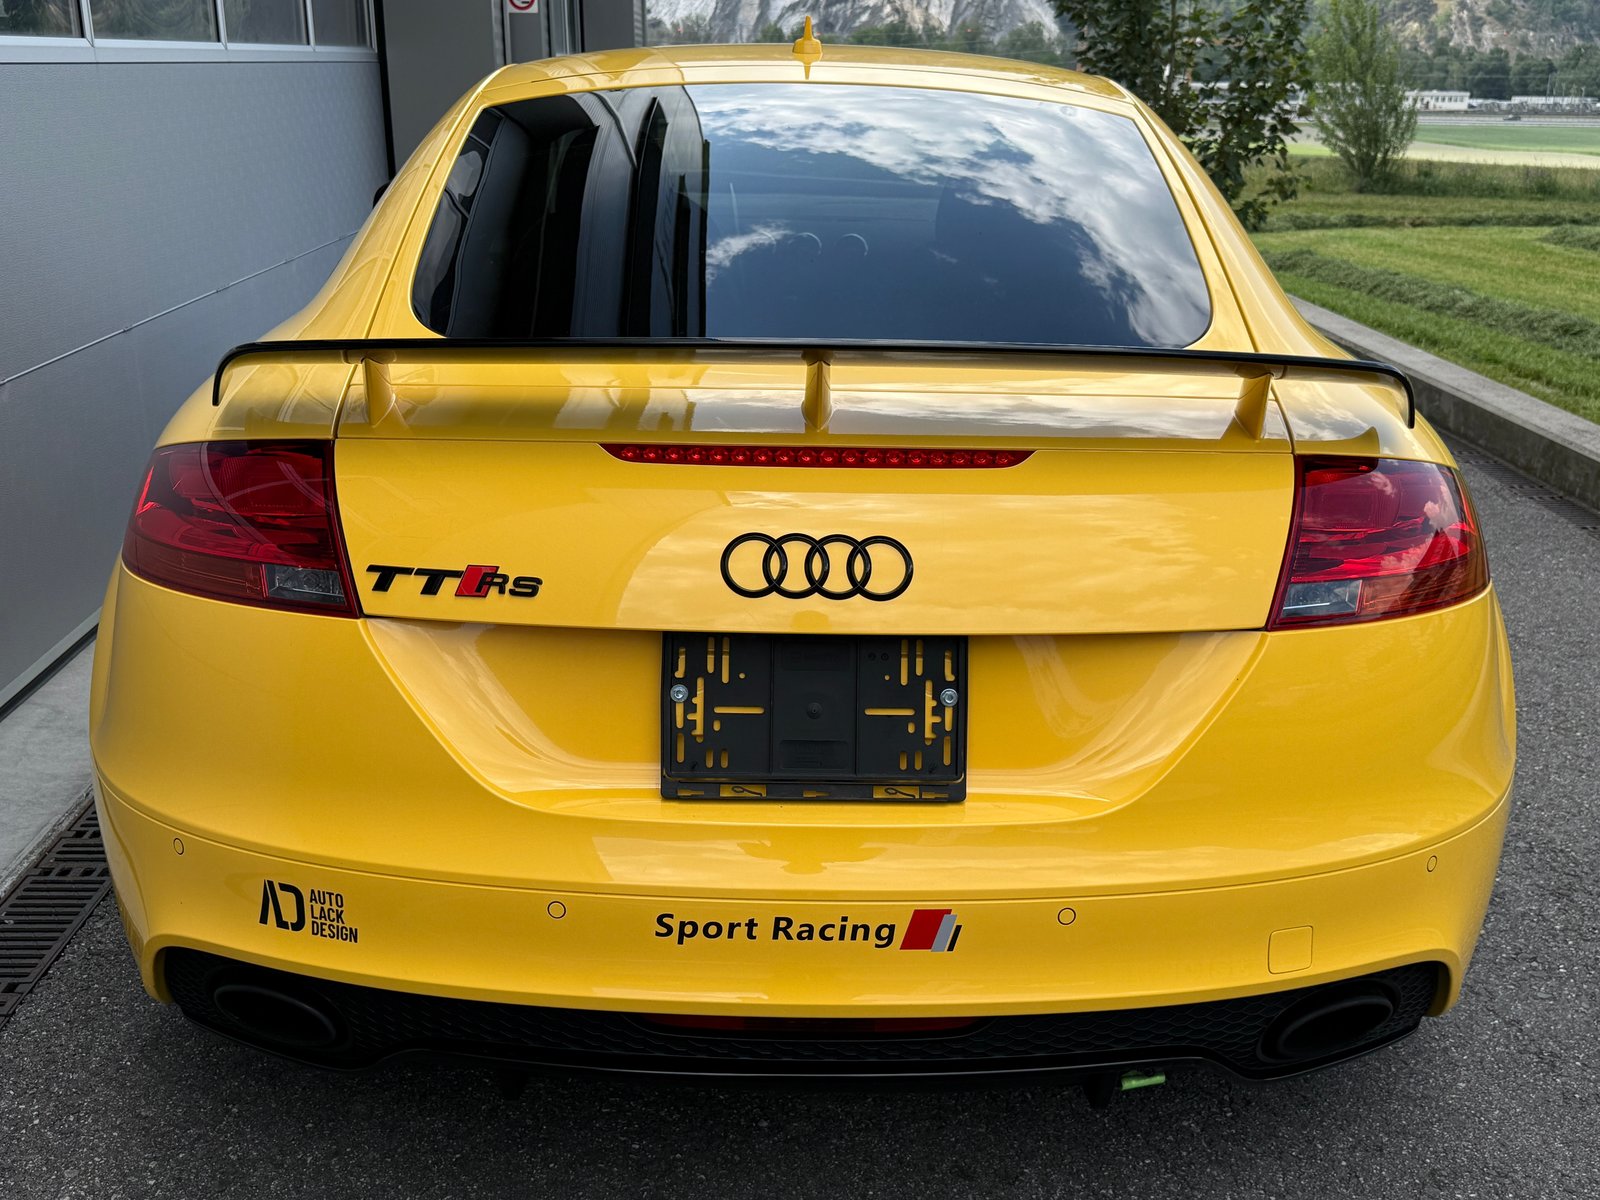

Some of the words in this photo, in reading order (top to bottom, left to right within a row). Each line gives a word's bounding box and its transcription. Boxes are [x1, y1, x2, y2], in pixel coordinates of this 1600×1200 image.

[309, 888, 344, 909] AUTO
[310, 904, 345, 925] LACK
[311, 920, 358, 944] DESIGN
[654, 912, 759, 945] Sport
[771, 915, 896, 949] Racing
